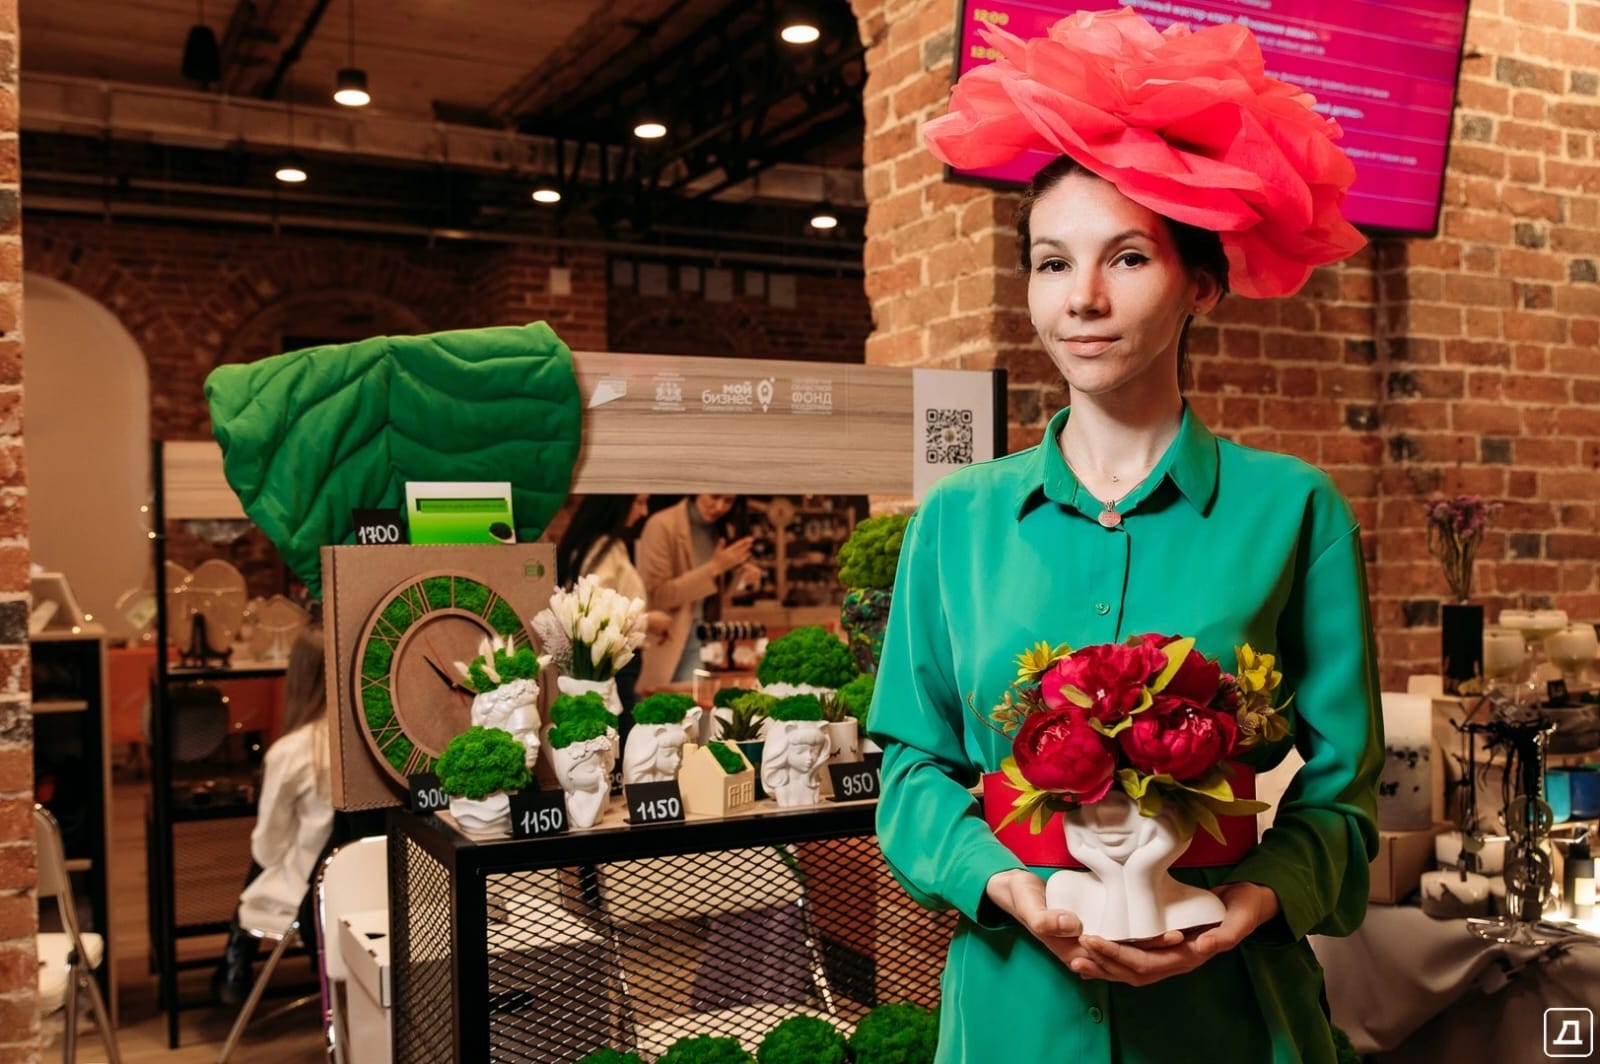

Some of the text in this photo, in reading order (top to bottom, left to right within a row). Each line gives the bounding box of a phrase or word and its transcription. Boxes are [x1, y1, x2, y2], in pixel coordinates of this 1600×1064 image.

[702, 389, 752, 405] бизнес
[722, 381, 752, 395] мой
[791, 391, 832, 405] ФОНД
[358, 524, 399, 545] 1700
[842, 772, 874, 796] 950
[636, 797, 680, 821] 1150
[520, 807, 563, 834] 1150
